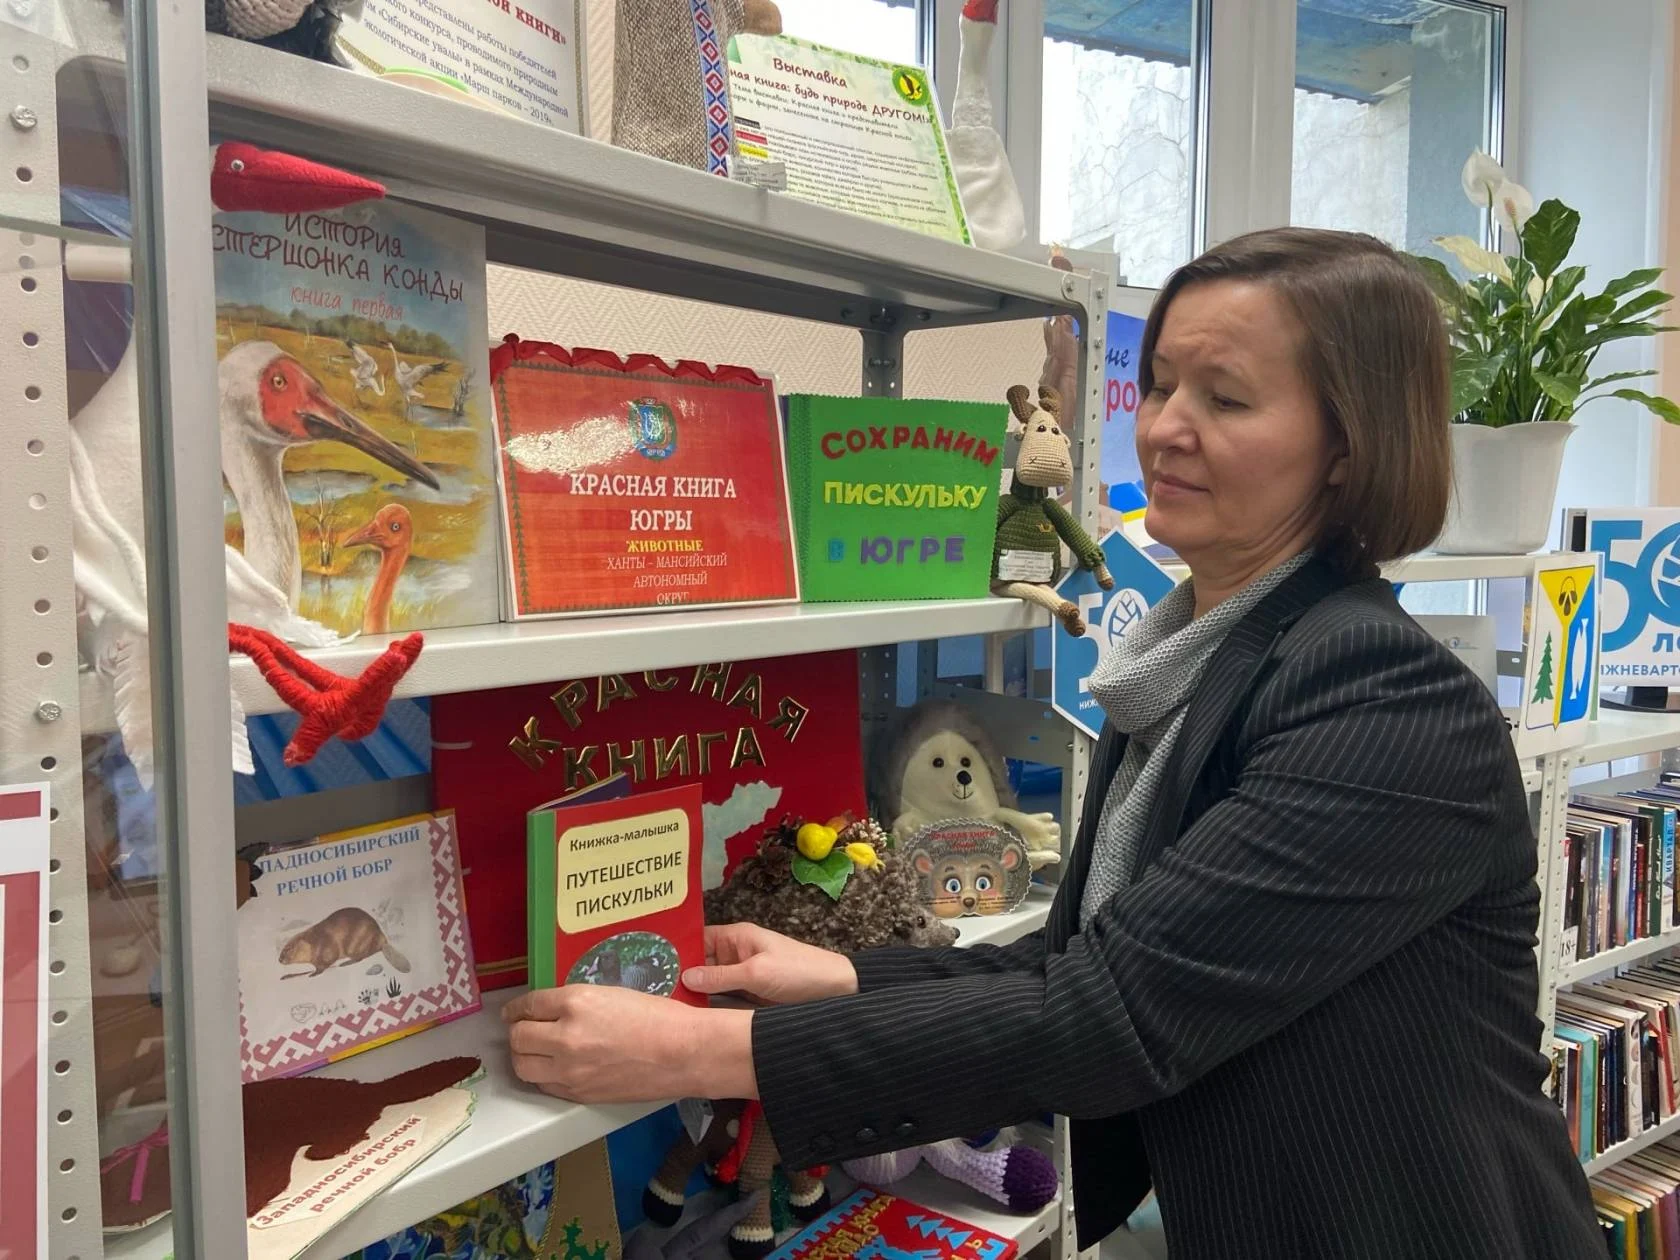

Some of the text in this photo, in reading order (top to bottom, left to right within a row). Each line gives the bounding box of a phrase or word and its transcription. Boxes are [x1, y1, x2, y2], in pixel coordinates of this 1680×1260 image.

[515, 6, 567, 45] КНИГИ»
[378, 8, 430, 46] «Сибирские
[473, 62, 504, 86] рамках
[506, 76, 569, 118] Международной
[410, 9, 454, 42] конкурса,
[456, 36, 511, 72] проводимого
[514, 64, 558, 96] природным
[477, 29, 507, 53] работы
[509, 46, 557, 80] победителей
[430, 58, 458, 79] акции
[460, 72, 490, 95] «Марш
[492, 88, 522, 110] парков
[773, 57, 848, 88] Выставка
[754, 75, 791, 92] книга:
[795, 83, 820, 99] будь
[823, 94, 868, 112] природе
[285, 213, 405, 258] ИСТОРИЯ
[290, 284, 404, 321] книга первая
[383, 263, 464, 305] КОНДЫ
[820, 425, 1000, 468] СОХРАНИМ
[569, 473, 737, 498] КРАСНАЯ КНИГА
[823, 481, 988, 510] ПИСКУЛЬКУ
[630, 509, 693, 531] ЮГРЫ
[607, 555, 645, 570] ХАНТЫ
[656, 552, 728, 569] МАНСИЙСКИЙ
[626, 539, 704, 553] ЖИВОТНЫЕ
[827, 535, 966, 566] В ЮГРЕ
[633, 572, 708, 588] АВТОНОМНЫЙ
[656, 592, 690, 606] ОКРУГ
[1600, 664, 1680, 676] ЖНЕВАРТ
[509, 662, 809, 772] КРАСНАЯ
[562, 726, 767, 793] КНИГА
[569, 821, 680, 852] Книжка-малышка
[276, 858, 393, 896] РЕЧНОЙ БОБР
[566, 851, 682, 890] ПУТЕШЕСТВИЕ
[575, 880, 674, 917] ПИСКУЛЬКИ
[256, 1115, 422, 1226] Западносибирский
[309, 1137, 416, 1213] речной бобр
